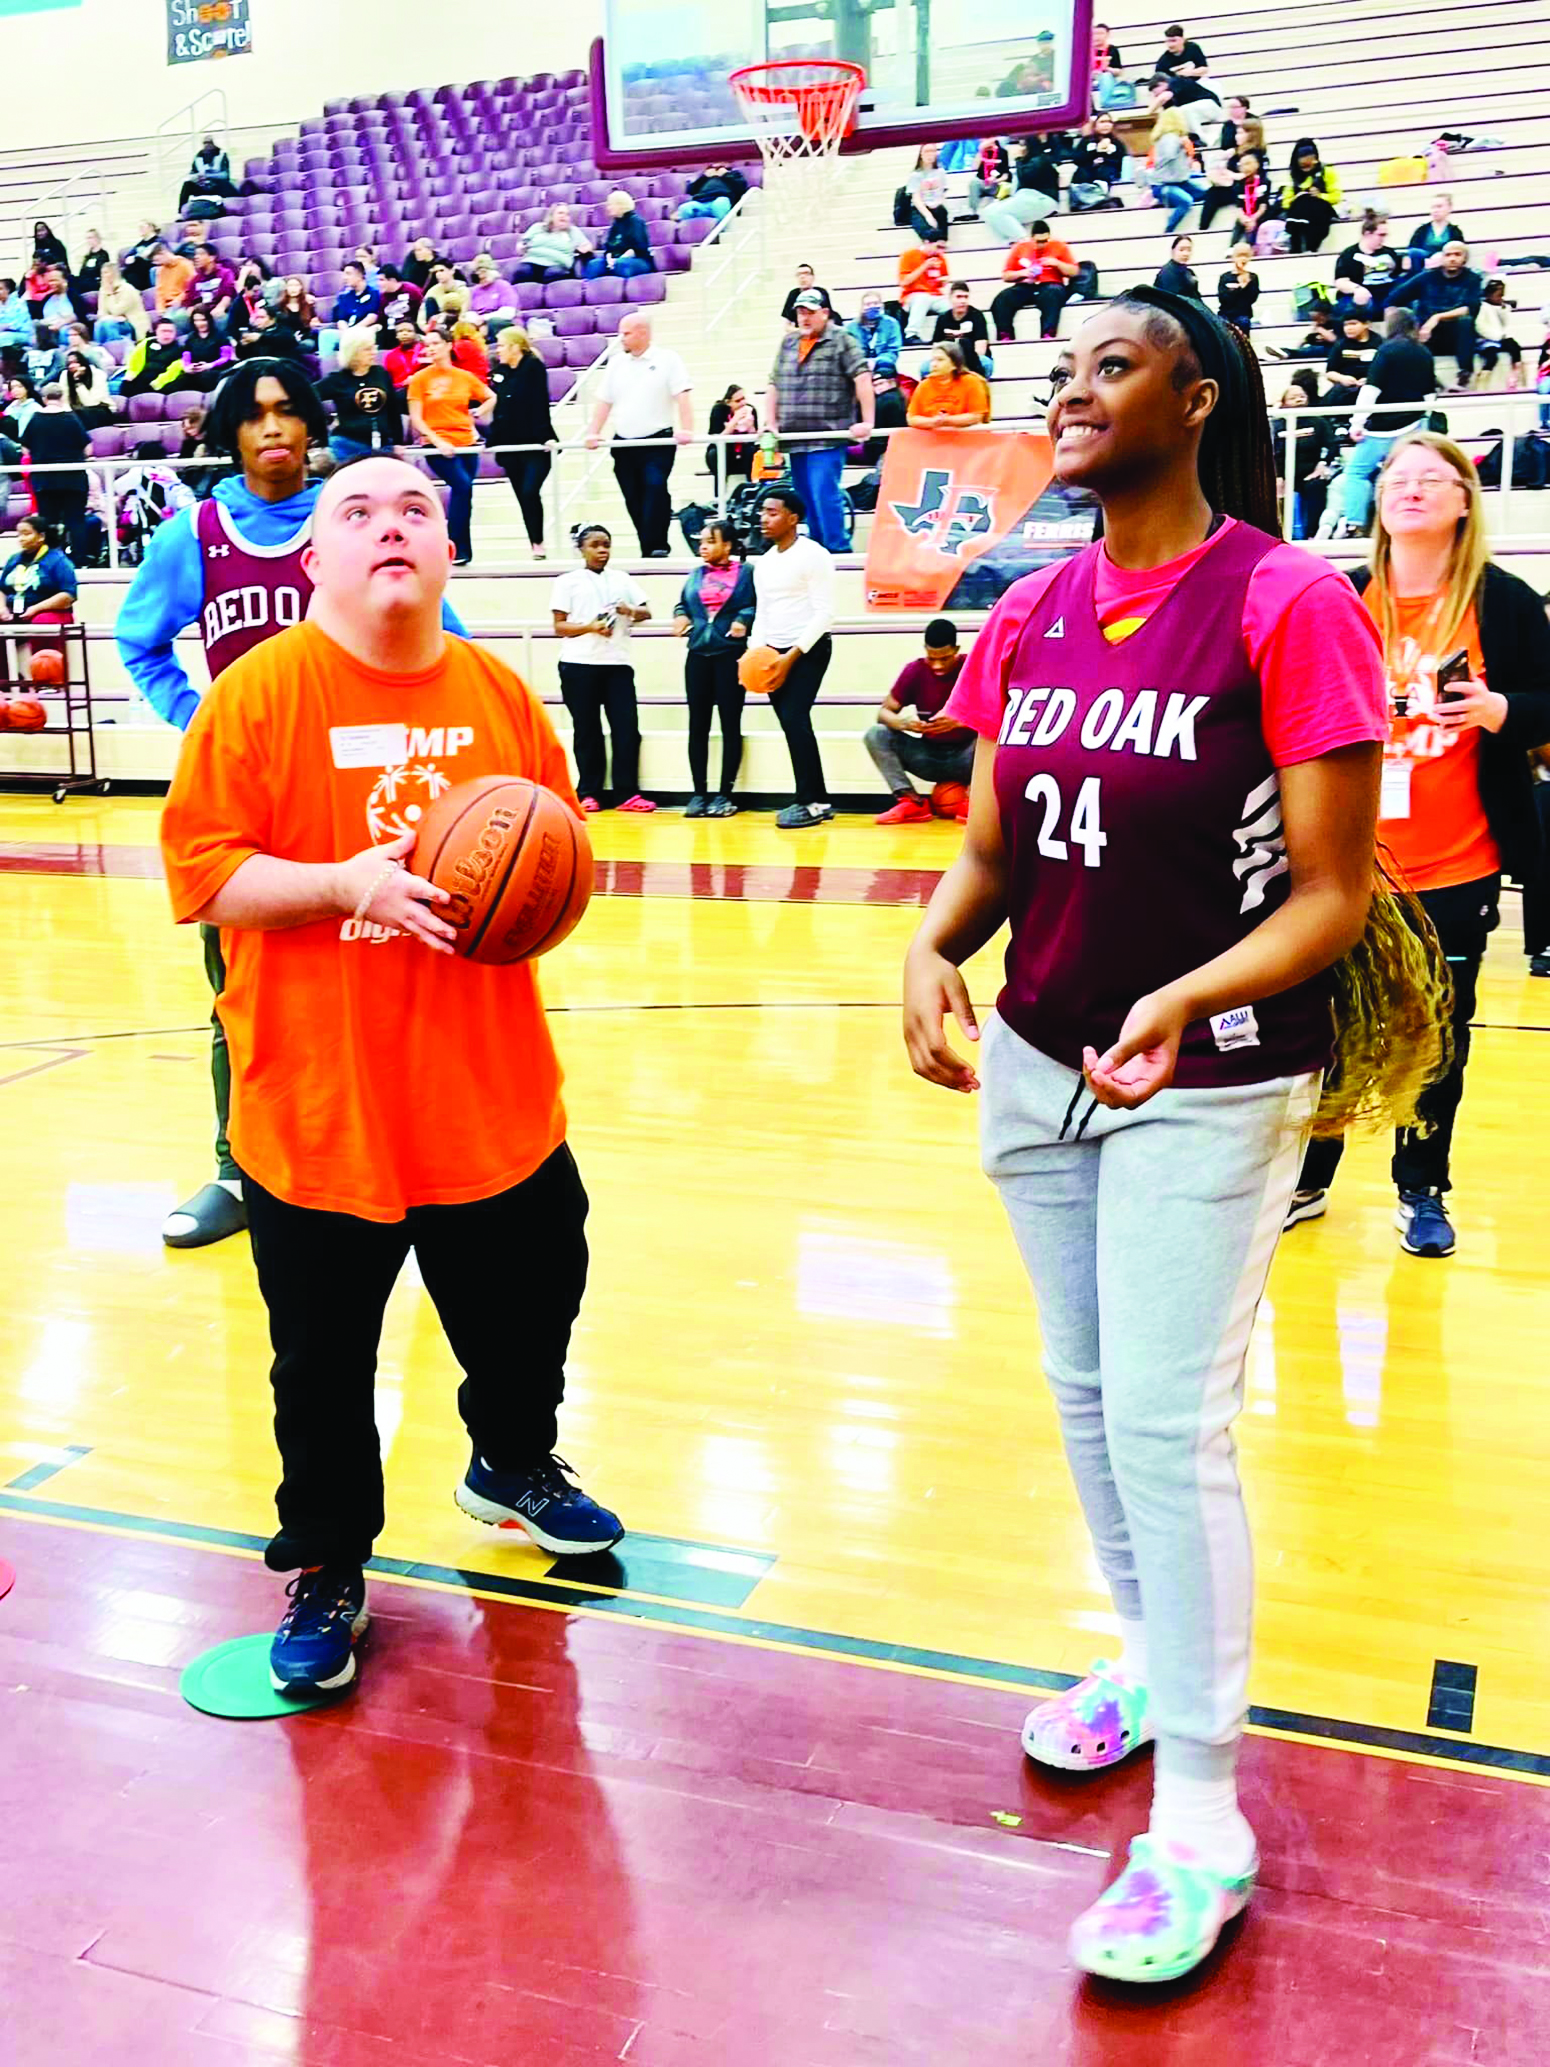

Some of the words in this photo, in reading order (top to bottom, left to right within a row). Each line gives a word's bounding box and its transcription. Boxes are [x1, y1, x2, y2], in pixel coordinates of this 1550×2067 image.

[1022, 521, 1096, 540] FERRIS
[203, 585, 269, 650] RED
[407, 726, 474, 758] MP
[998, 687, 1077, 746] RED
[1080, 688, 1211, 761] OAK
[1024, 773, 1108, 868] 24
